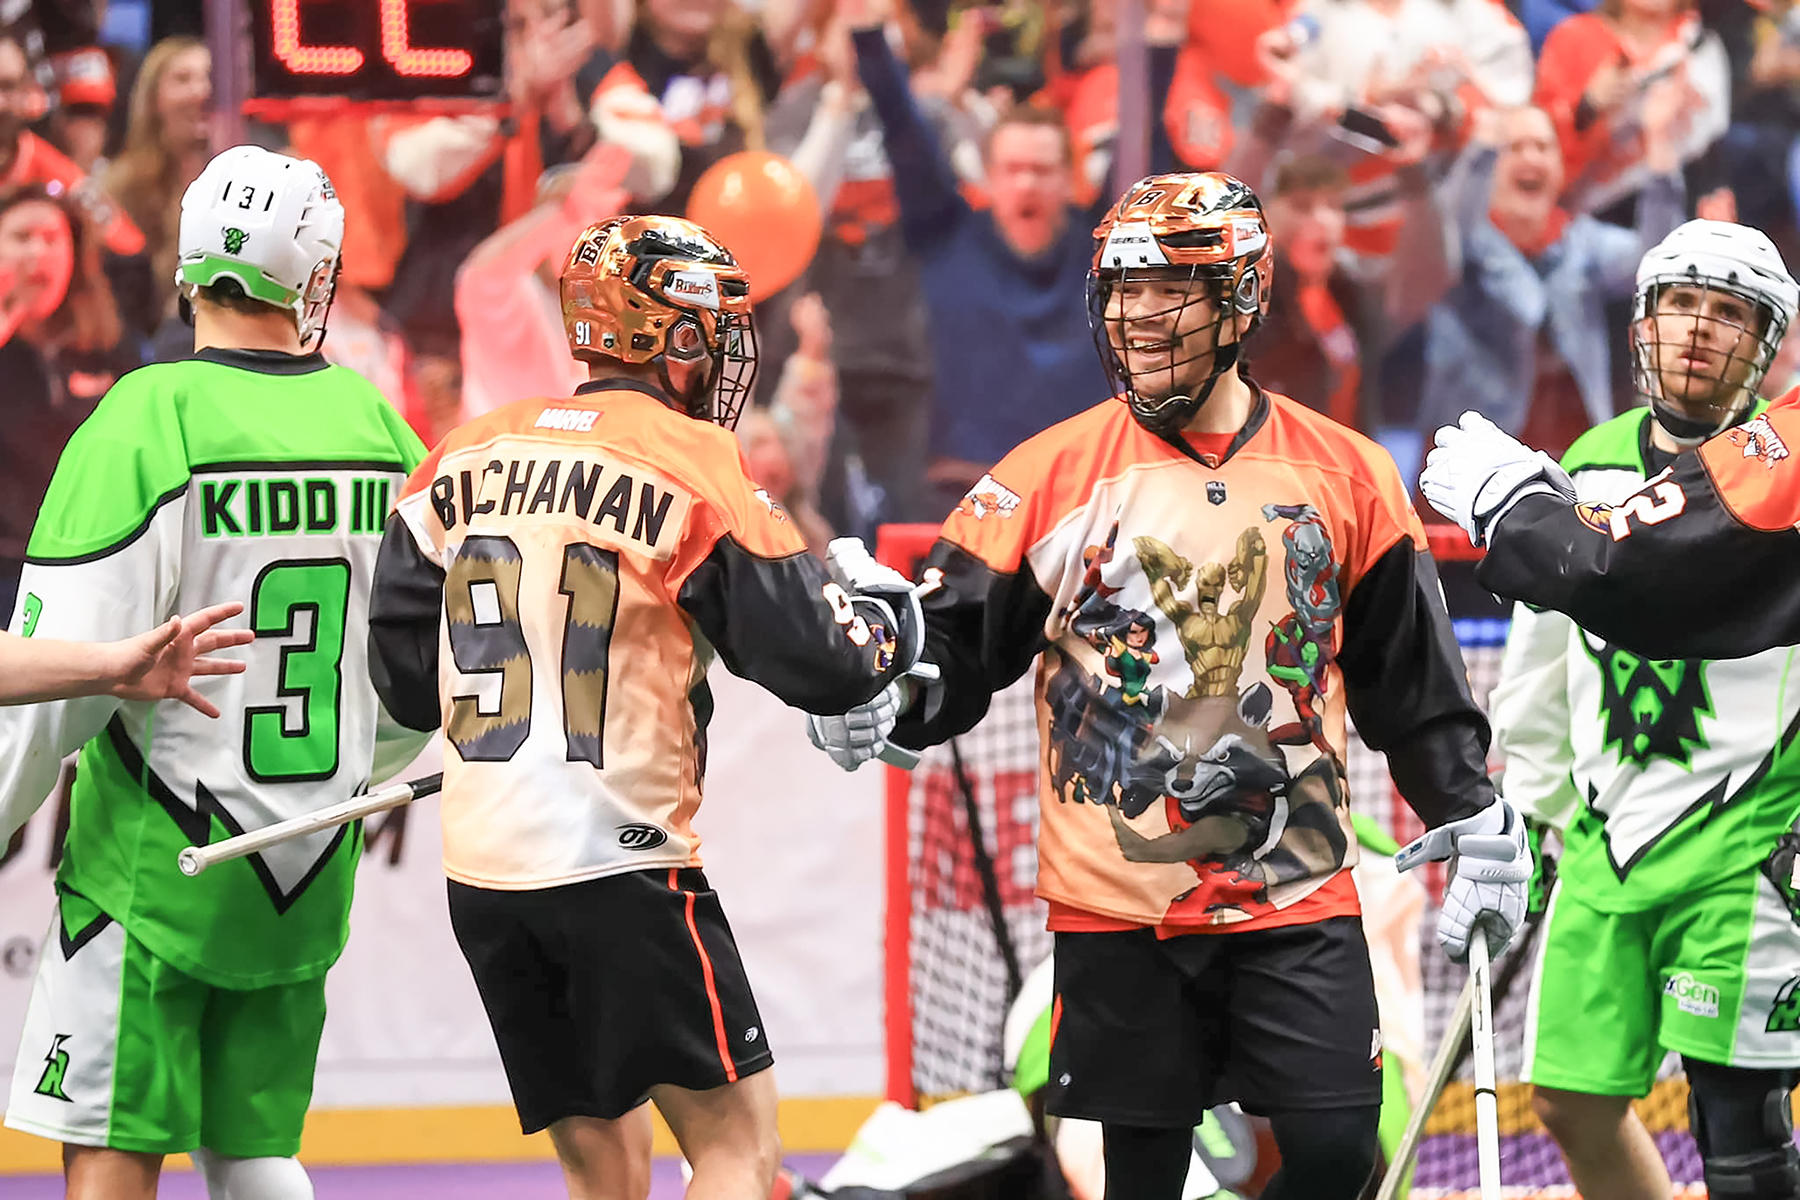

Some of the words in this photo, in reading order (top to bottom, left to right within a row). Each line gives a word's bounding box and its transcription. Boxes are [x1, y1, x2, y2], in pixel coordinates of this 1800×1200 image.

[575, 321, 591, 345] 91
[534, 408, 601, 432] MARVEL
[201, 479, 339, 537] KIDD
[243, 557, 351, 784] 3
[444, 534, 621, 770] 91
